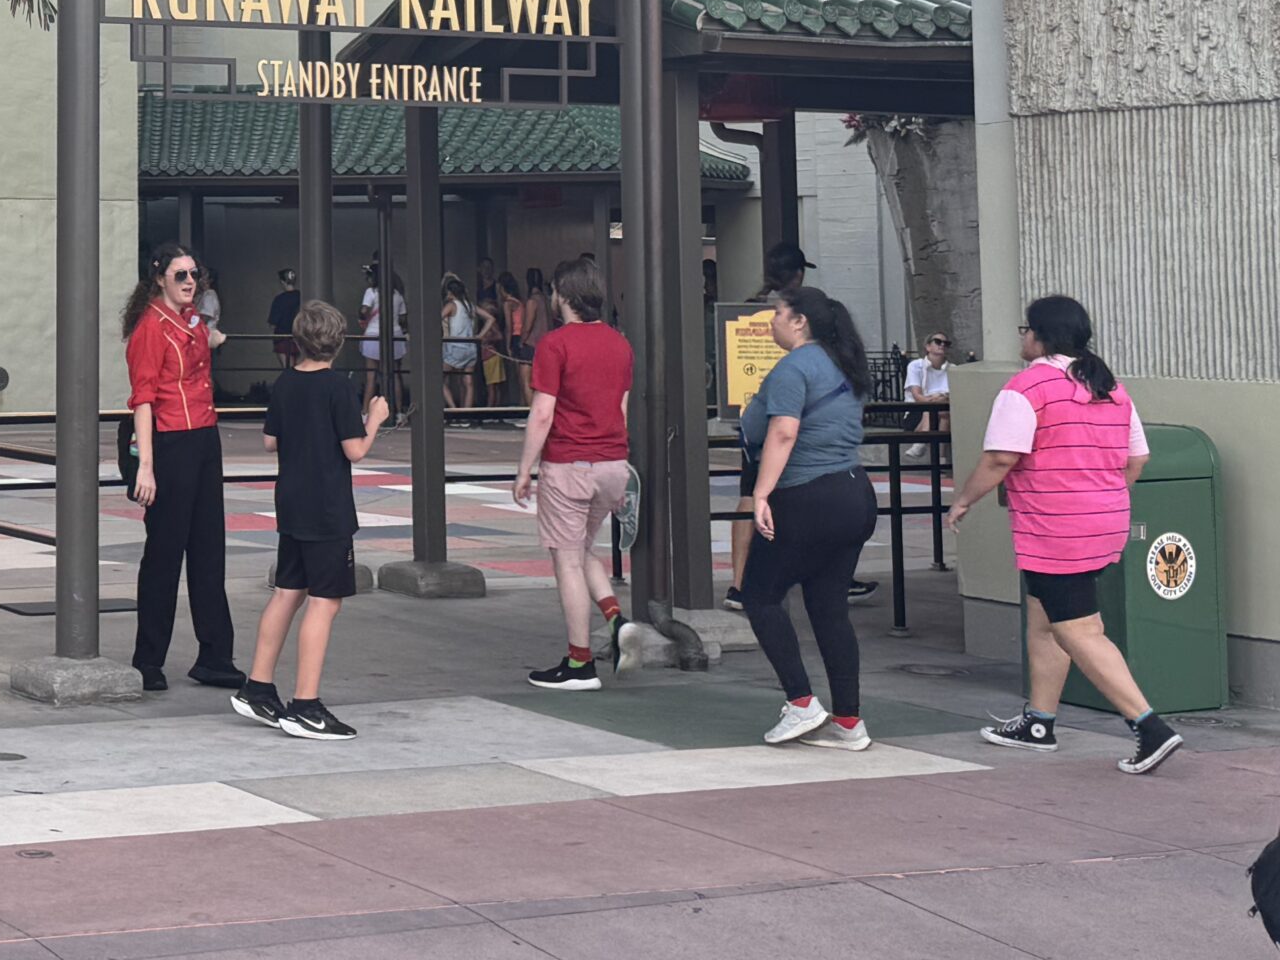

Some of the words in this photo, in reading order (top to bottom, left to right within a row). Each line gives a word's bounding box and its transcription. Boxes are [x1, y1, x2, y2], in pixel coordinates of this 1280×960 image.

[257, 59, 360, 100] STANDBY
[369, 62, 483, 104] ENTRANCE
[1149, 539, 1164, 565] PLEASE
[1166, 535, 1182, 543] HELP
[1183, 543, 1193, 561] KEEP
[1151, 574, 1162, 591] OUR
[1162, 588, 1177, 597] CITY
[1179, 571, 1193, 593] CLEAN
